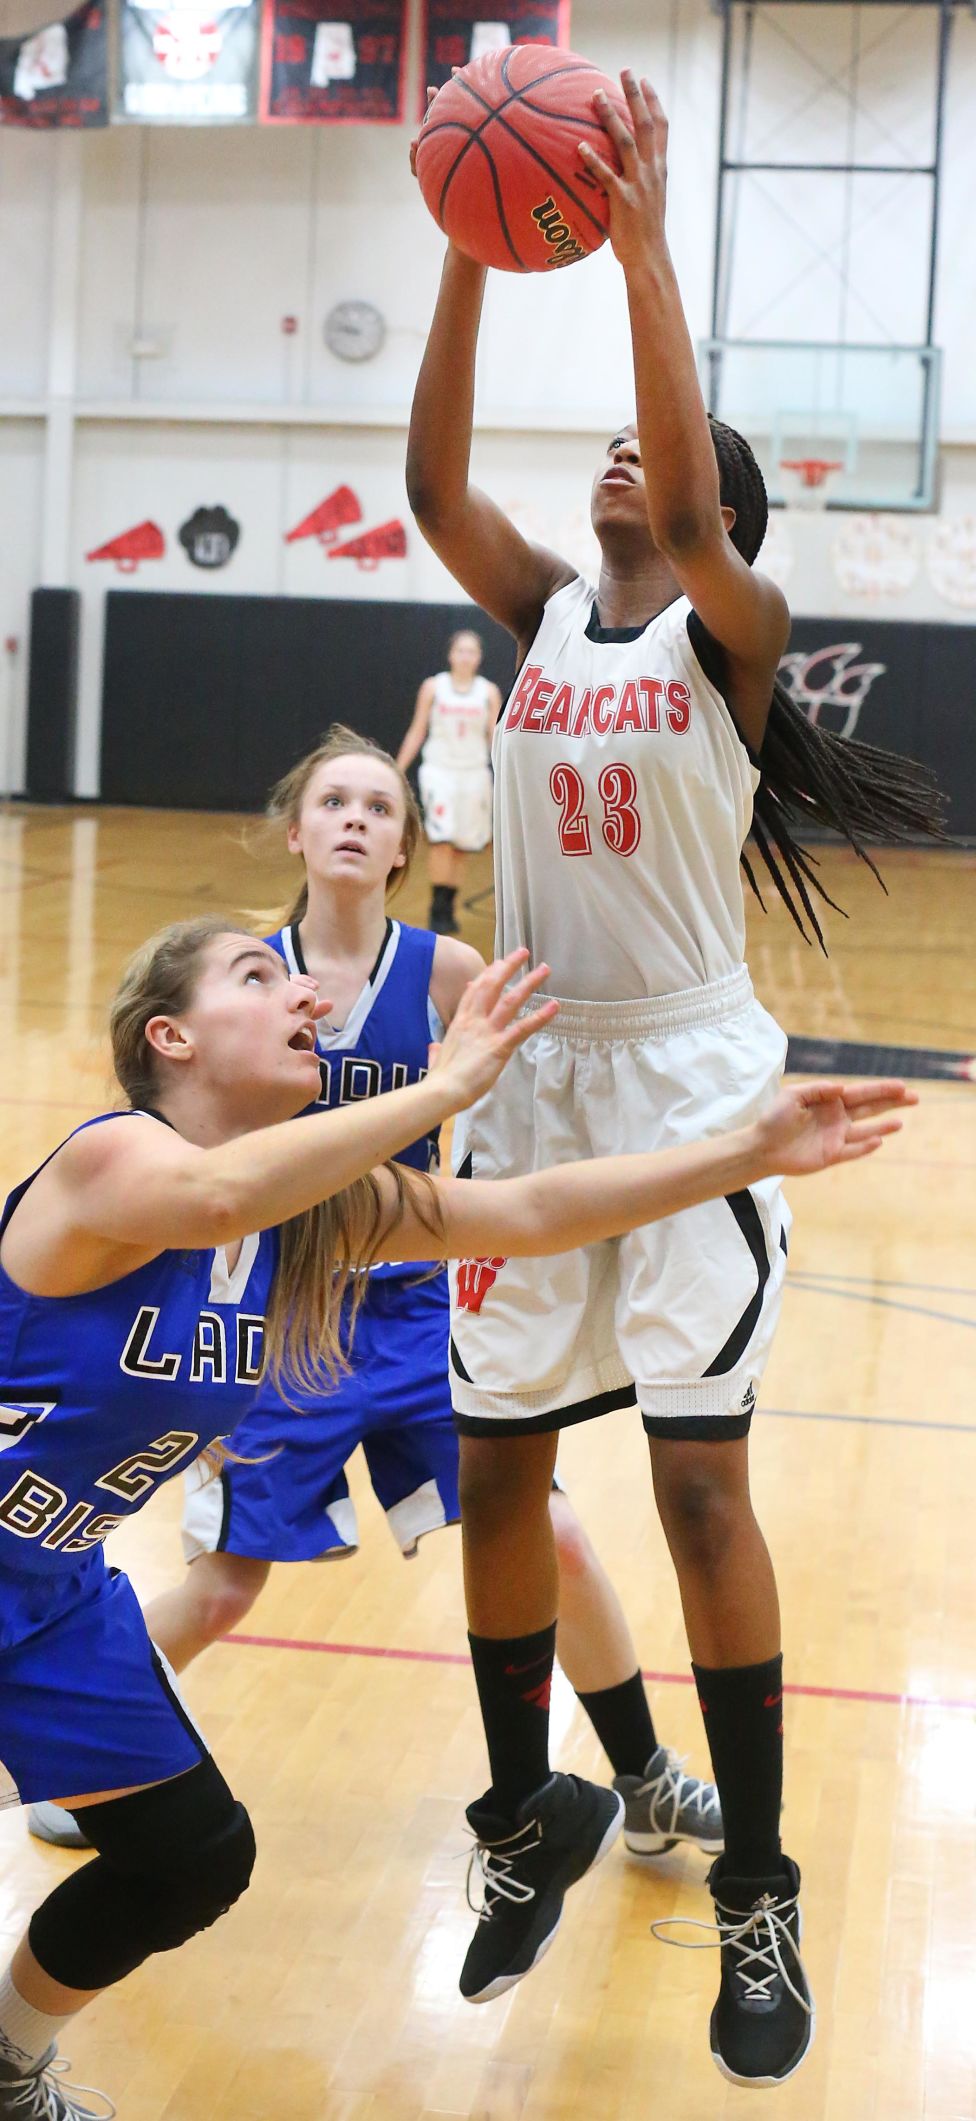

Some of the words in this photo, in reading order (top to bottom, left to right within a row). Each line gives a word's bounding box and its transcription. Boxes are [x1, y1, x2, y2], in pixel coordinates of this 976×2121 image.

[550, 762, 641, 857] 23
[120, 1306, 266, 1385] LAD
[95, 1430, 200, 1502] 2
[0, 1470, 128, 1552] BIS
